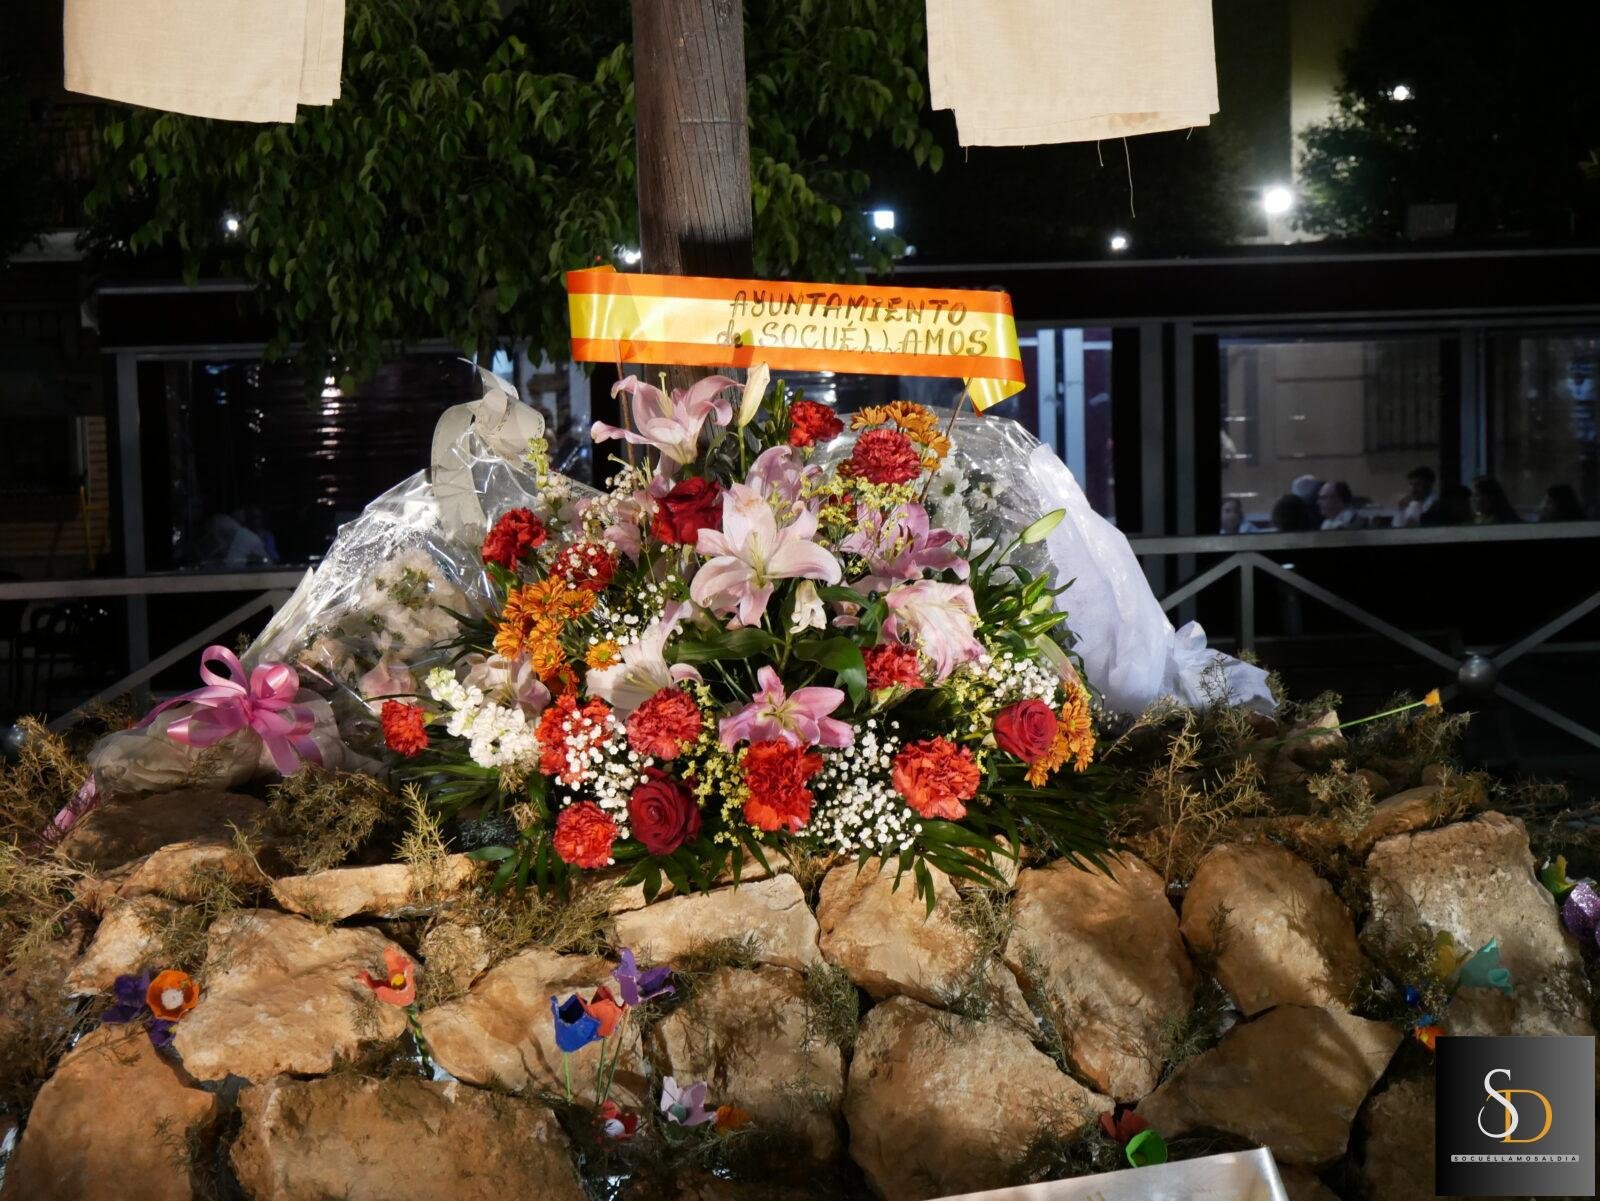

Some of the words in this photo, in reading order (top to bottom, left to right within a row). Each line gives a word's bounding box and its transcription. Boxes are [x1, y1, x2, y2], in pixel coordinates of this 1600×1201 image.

[730, 290, 967, 325] AYUNTAMIENTO
[716, 319, 743, 348] de
[759, 321, 988, 356] SOCUÉLLAMOS
